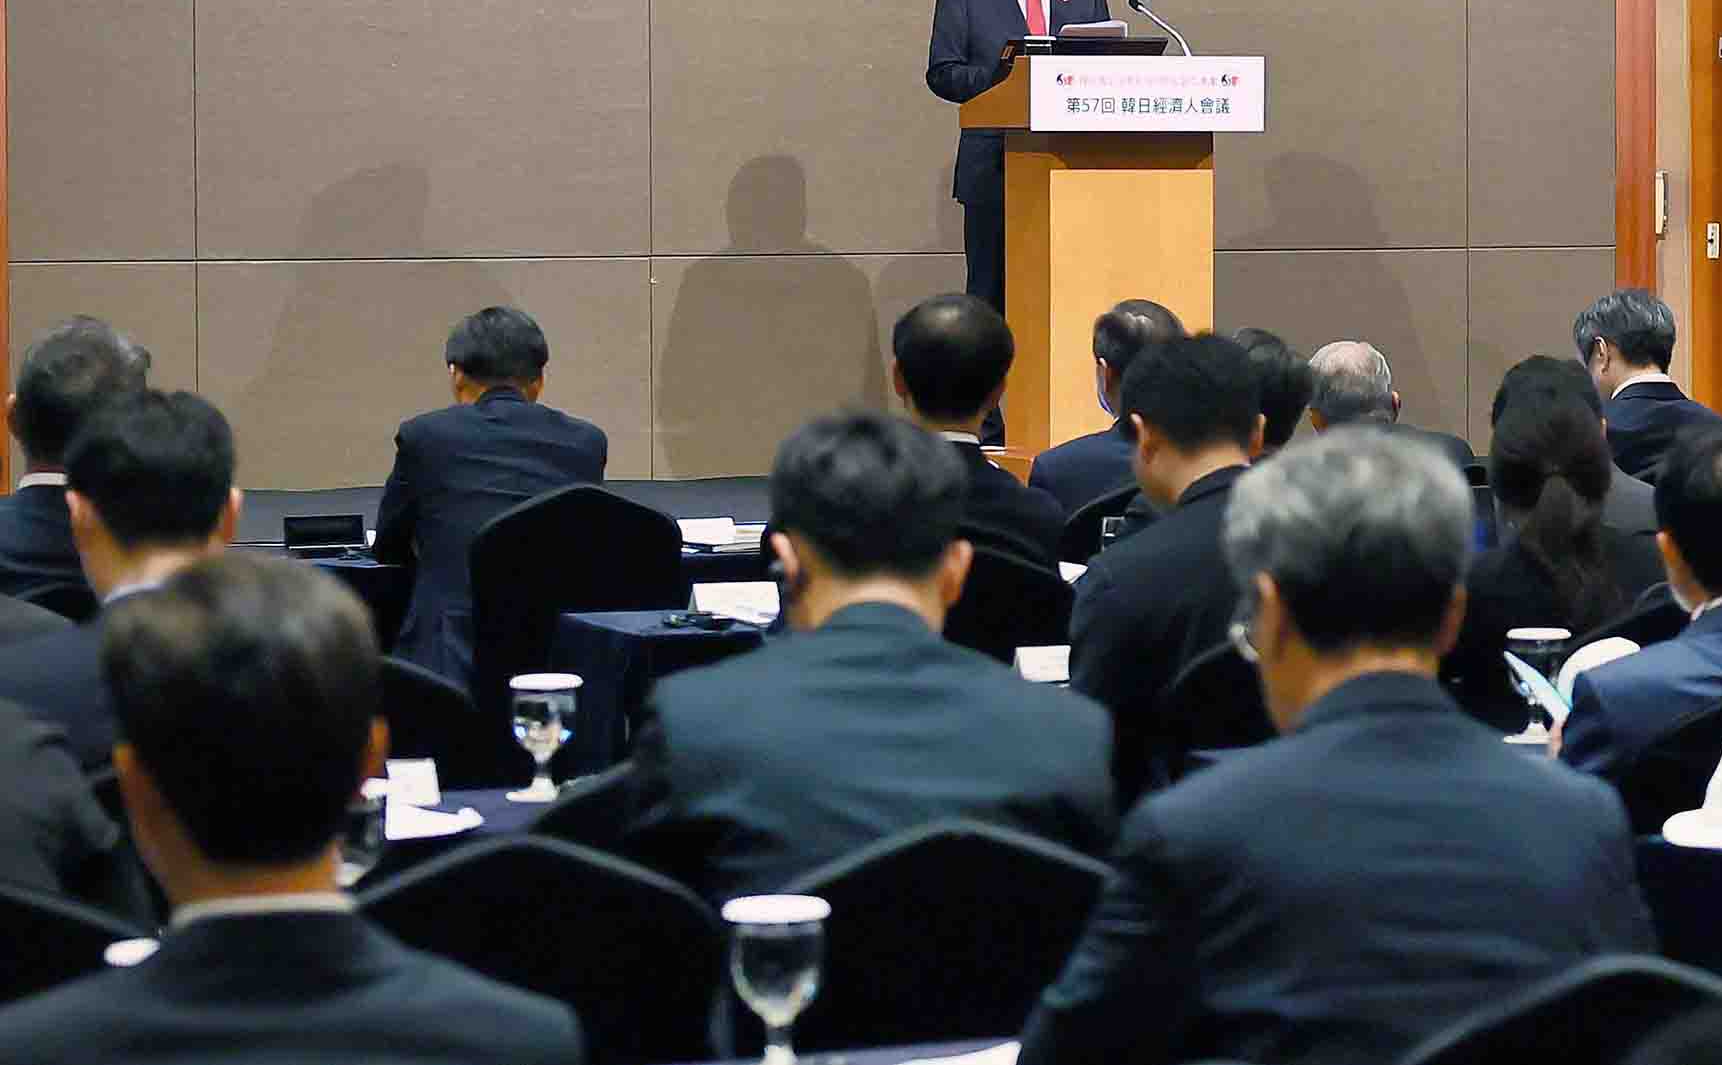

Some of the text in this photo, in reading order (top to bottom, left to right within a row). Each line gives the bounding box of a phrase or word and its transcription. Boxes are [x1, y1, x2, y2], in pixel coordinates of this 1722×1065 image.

[1067, 98, 1229, 113] 第57回 韓日經濟人會議
